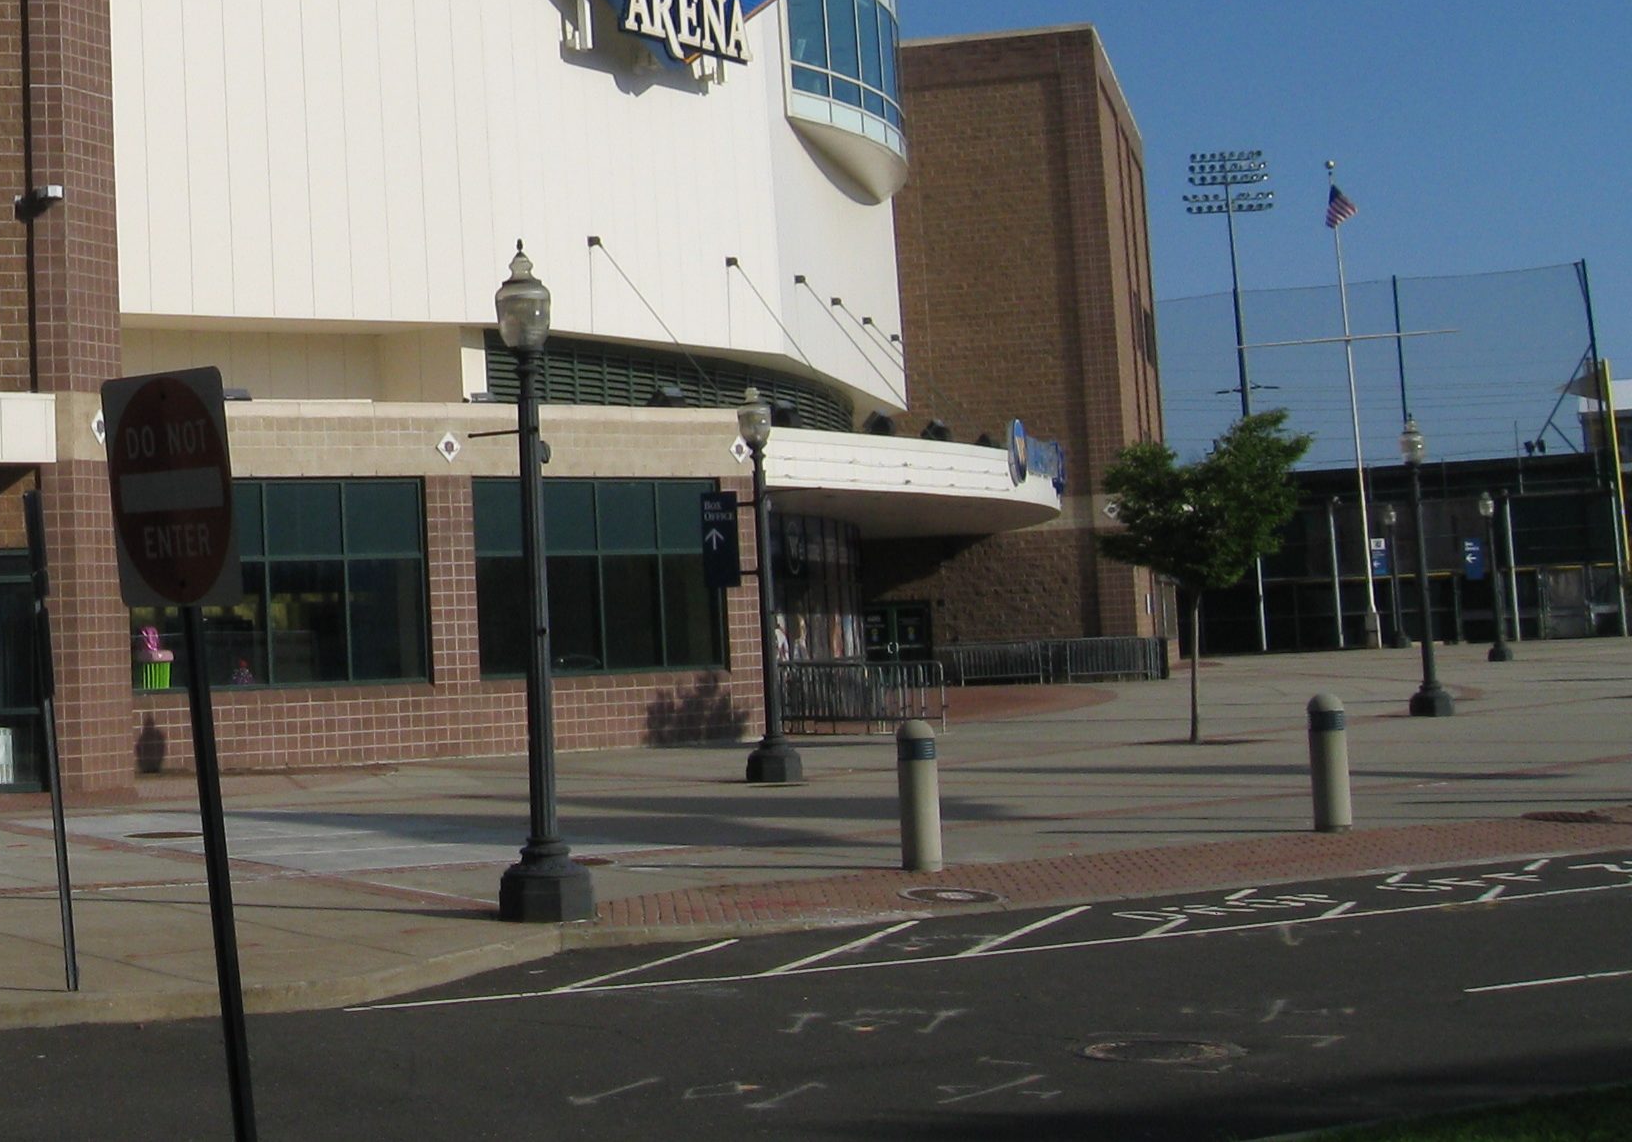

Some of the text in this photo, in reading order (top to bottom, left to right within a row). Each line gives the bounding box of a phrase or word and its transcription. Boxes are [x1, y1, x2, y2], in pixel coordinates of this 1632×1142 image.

[125, 419, 207, 459] DO NOT
[143, 522, 211, 560] ENTER
